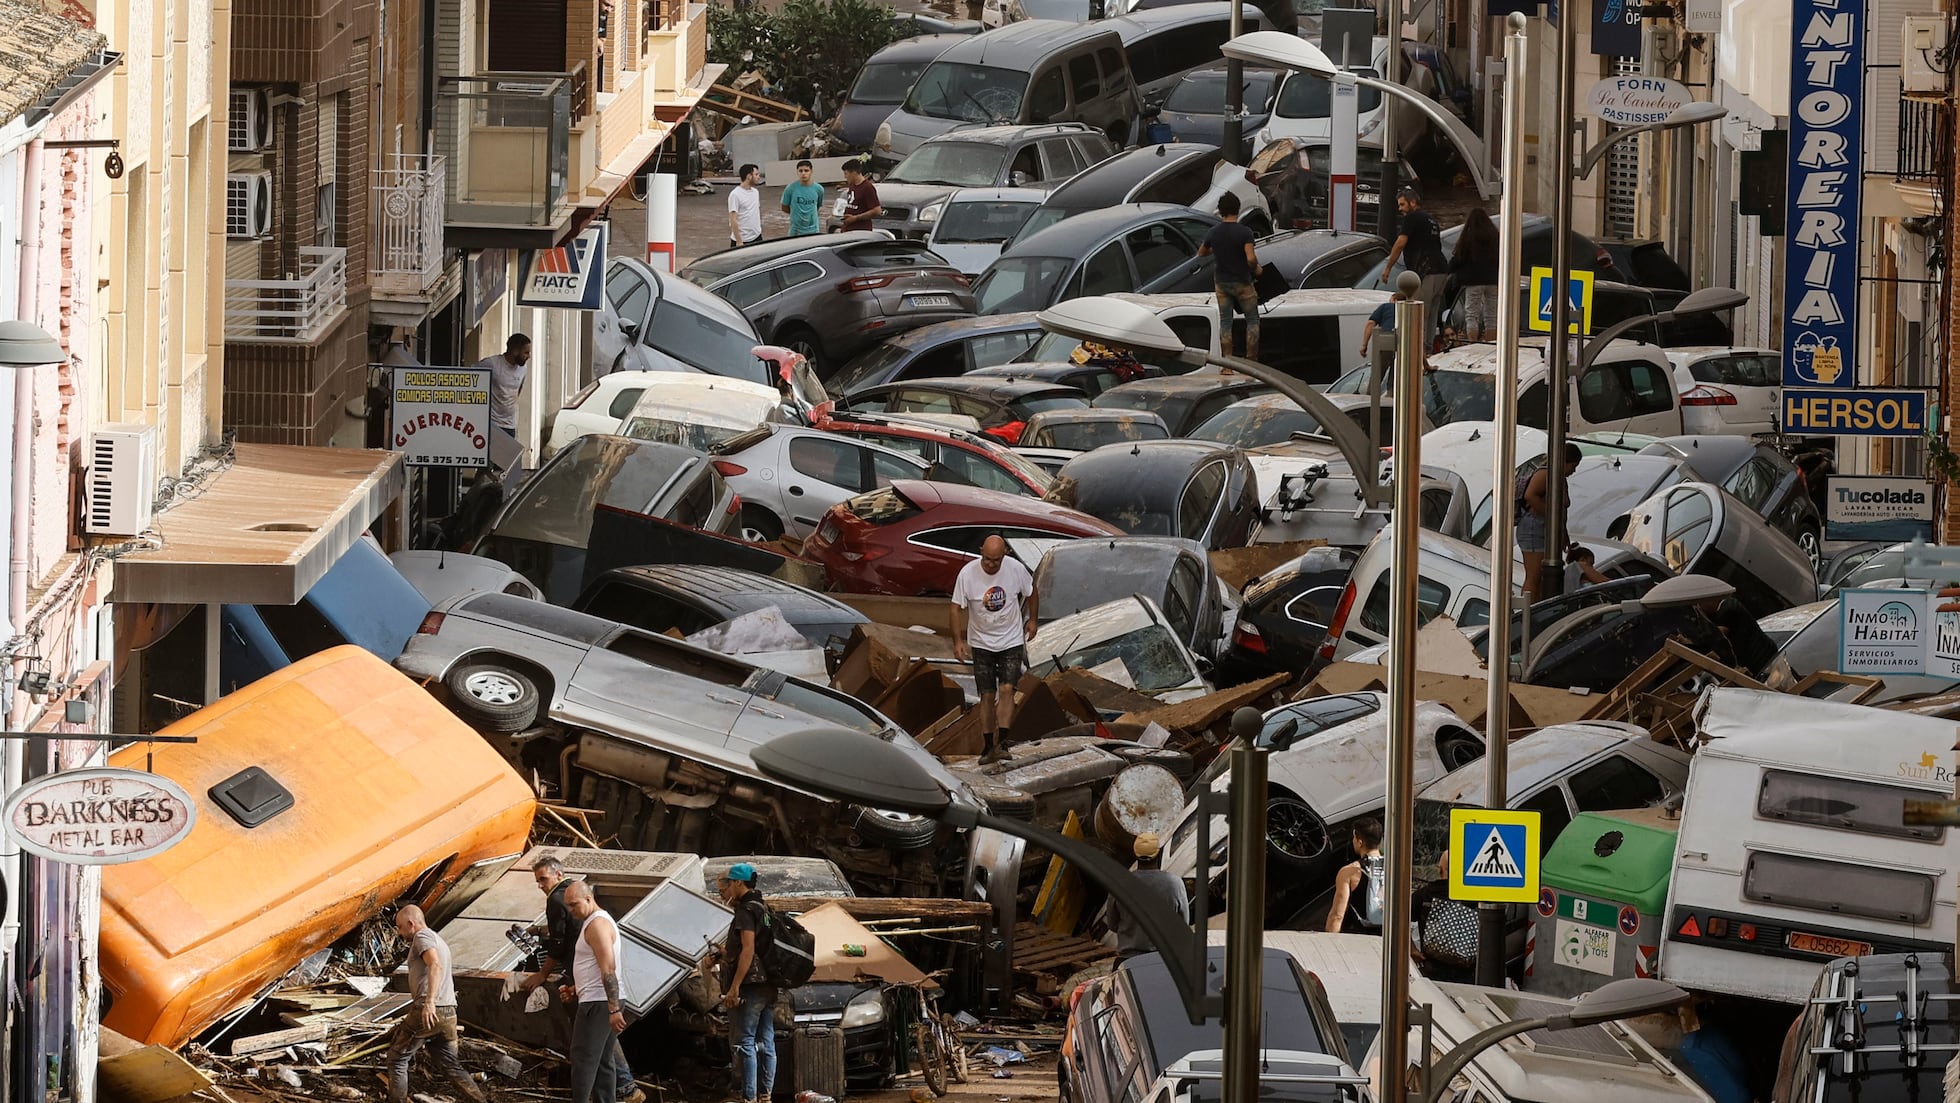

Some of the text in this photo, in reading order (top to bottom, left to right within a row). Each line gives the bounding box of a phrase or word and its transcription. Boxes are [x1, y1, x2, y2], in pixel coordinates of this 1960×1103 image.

[1625, 9, 1641, 25] ÒP
[1617, 79, 1666, 93] FORN
[1597, 90, 1681, 110] La Carretera
[1602, 107, 1673, 123] PASTISSERI
[1792, 0, 1854, 327] NTORERIA
[533, 275, 578, 289] FIATC
[531, 287, 576, 295] SEGUROS
[405, 372, 479, 387] POLLOS ASADOS Y
[396, 389, 488, 405] COMIDAS PARA LLEVAR
[1786, 397, 1921, 430] HERSOL
[395, 412, 486, 450] GUERRERO
[416, 455, 429, 463] 96
[432, 456, 452, 464] 375
[455, 456, 469, 464] 70
[1835, 488, 1925, 504] Tucolada
[1936, 624, 1960, 655] INM
[1897, 761, 1955, 783] Sun Ro
[82, 779, 113, 796] PUB
[24, 798, 174, 827] DARKNESS
[50, 828, 146, 848] METAL BAR
[1584, 928, 1610, 938] ALFAFAR
[1592, 947, 1608, 958] TOTS
[1809, 937, 1850, 955] 05662
